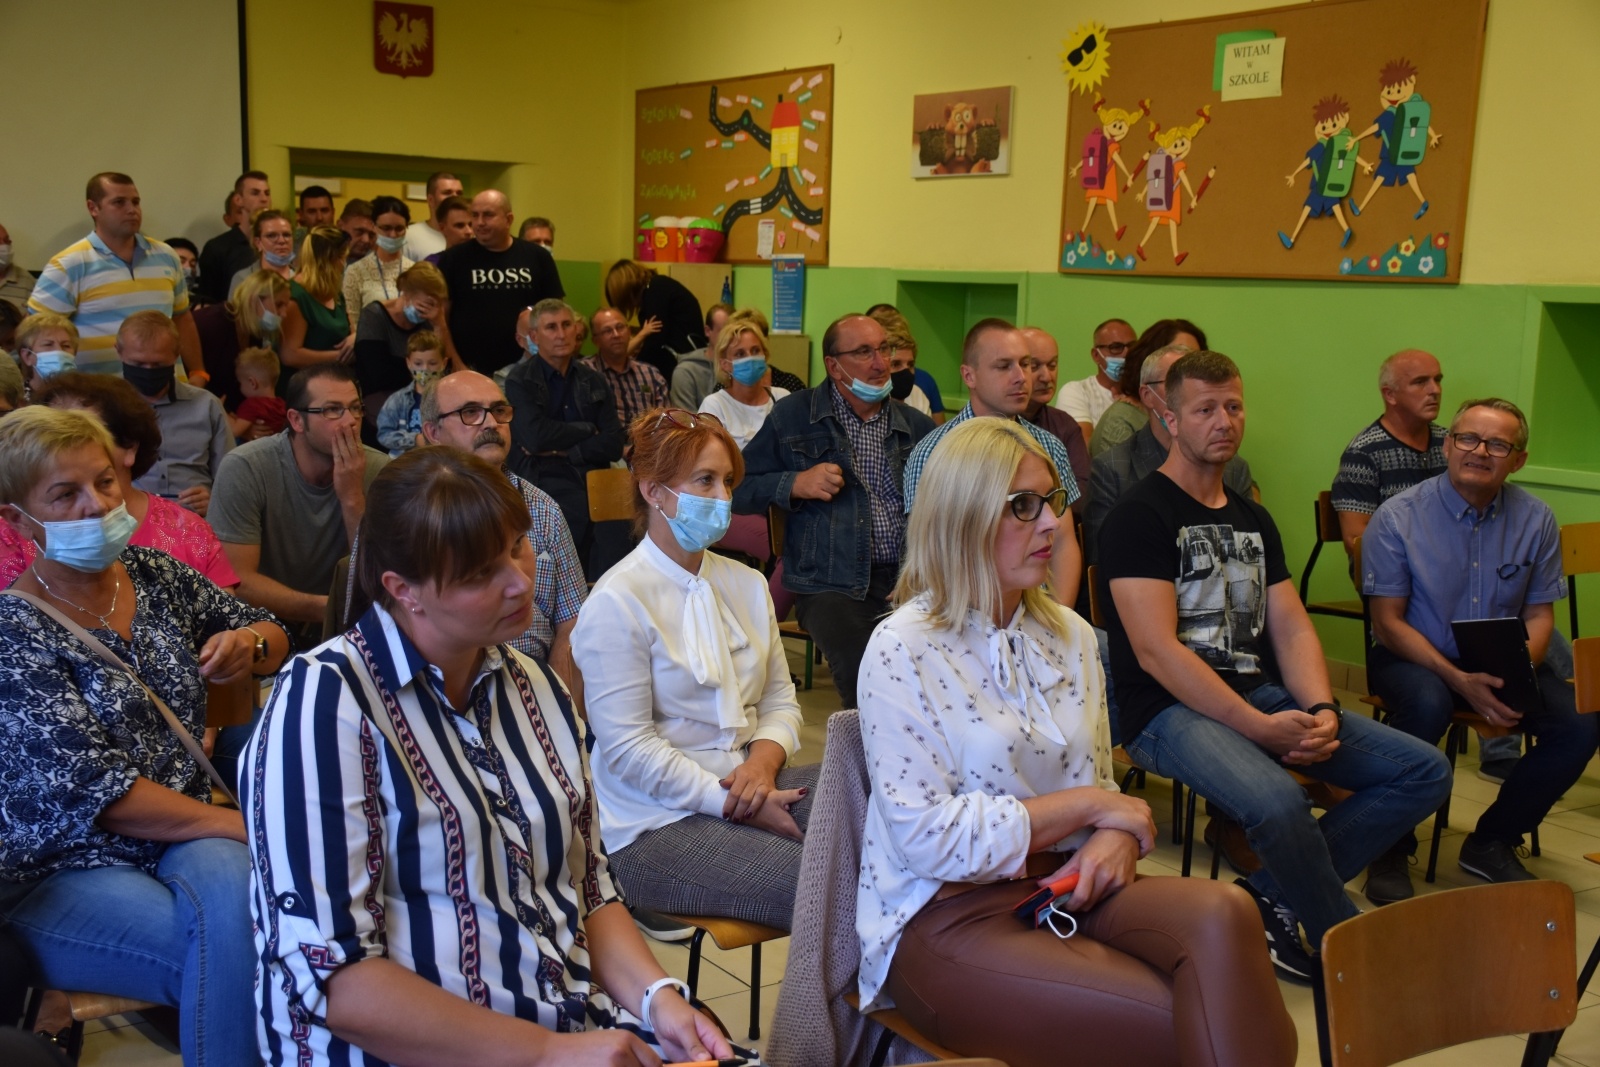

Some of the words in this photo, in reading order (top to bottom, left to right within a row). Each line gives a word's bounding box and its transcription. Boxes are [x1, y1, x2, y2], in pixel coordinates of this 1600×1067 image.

[1233, 44, 1270, 58] WITAM
[1229, 72, 1269, 87] SZKOLE
[471, 268, 532, 284] BOSS
